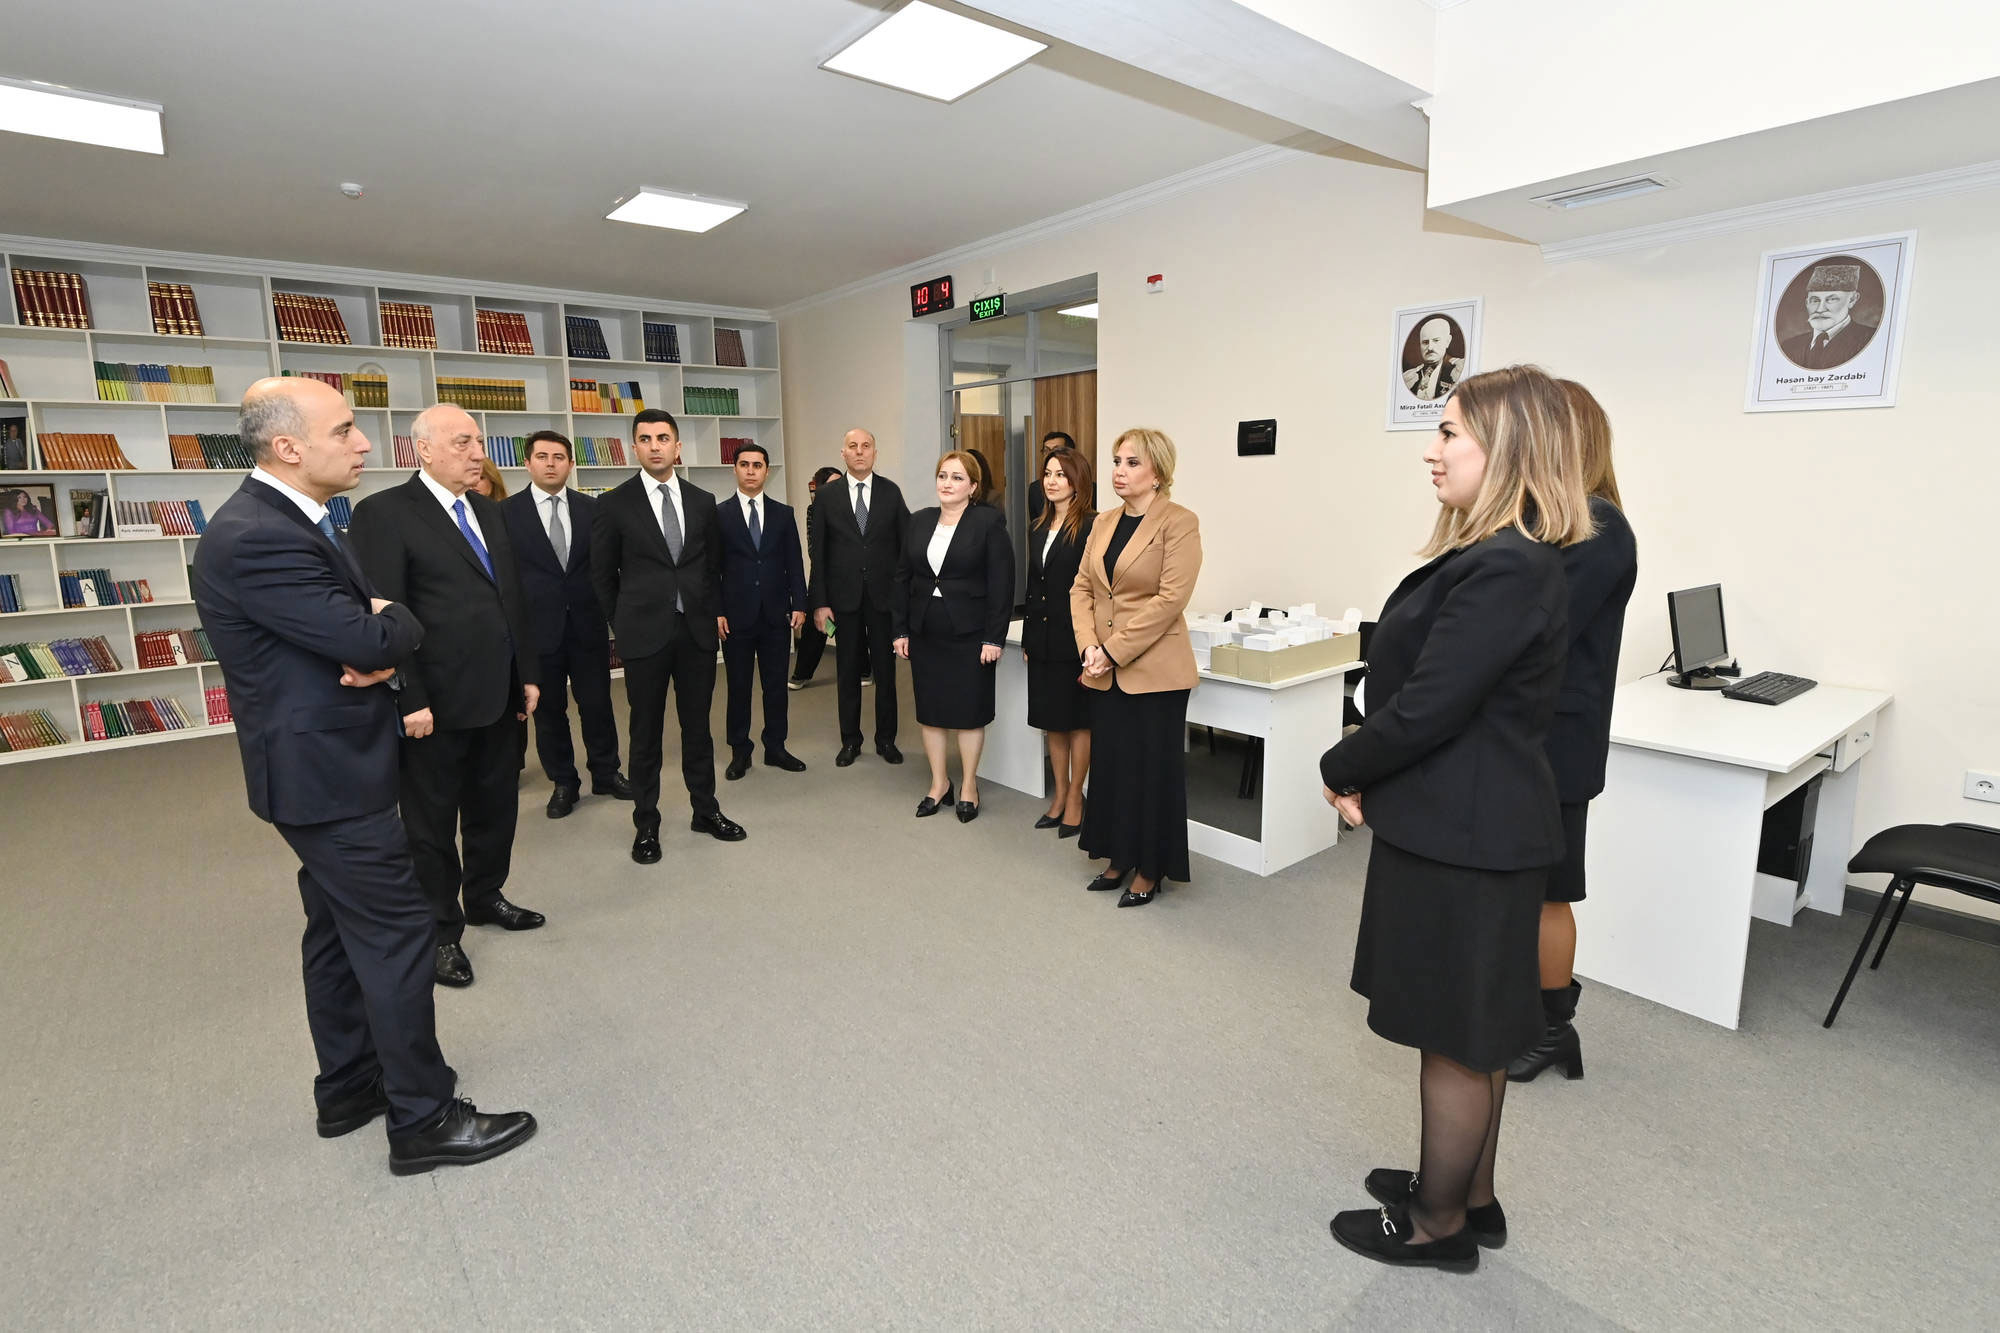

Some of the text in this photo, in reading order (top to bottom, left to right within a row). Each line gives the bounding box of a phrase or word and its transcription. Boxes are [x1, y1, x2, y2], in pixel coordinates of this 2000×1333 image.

[917, 286, 929, 305] 10
[973, 297, 1001, 314] ÇIXIŞ
[979, 309, 995, 319] EXIT
[1807, 375, 1825, 384] bəy
[1828, 372, 1866, 381] Zərdabi
[83, 583, 94, 593] A
[172, 645, 183, 655] R
[6, 655, 20, 668] N
